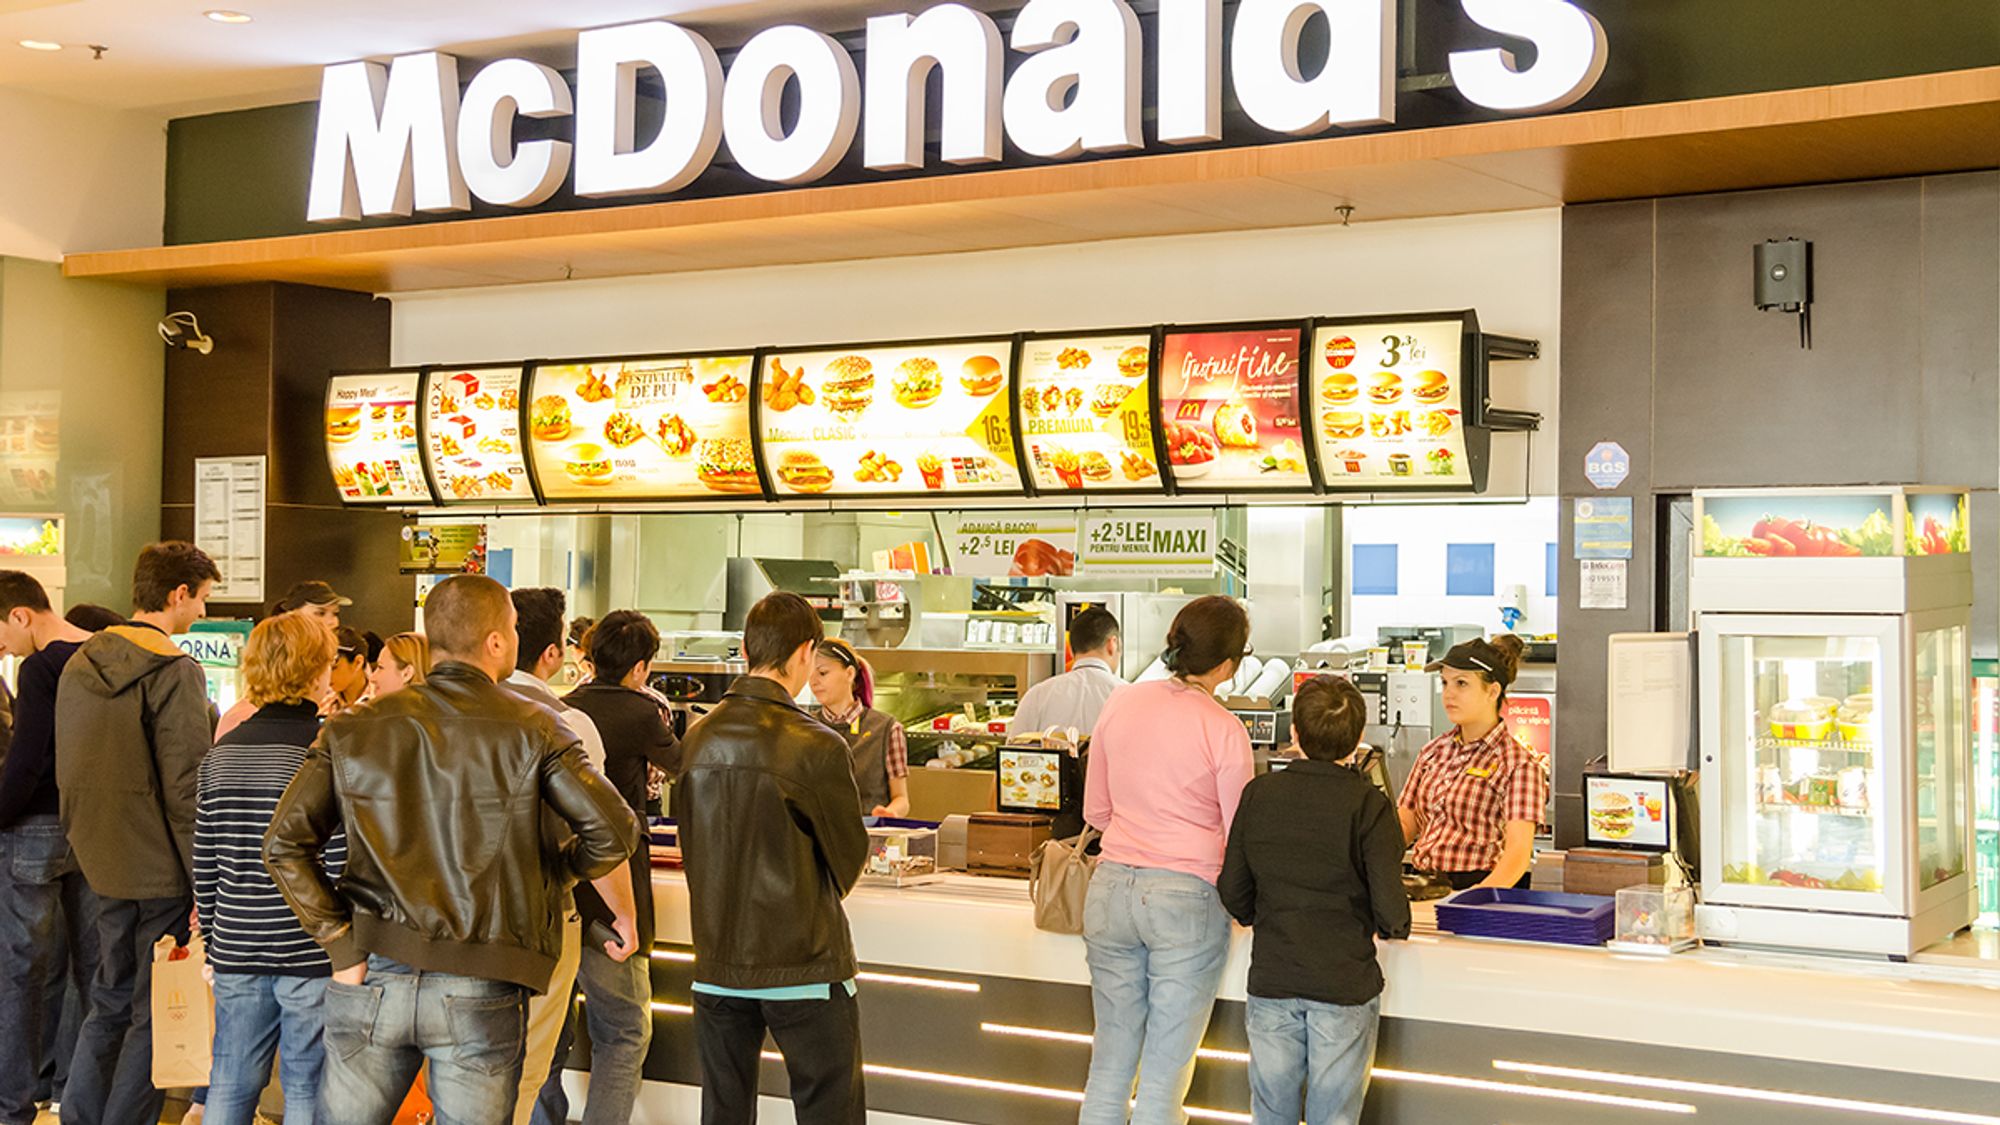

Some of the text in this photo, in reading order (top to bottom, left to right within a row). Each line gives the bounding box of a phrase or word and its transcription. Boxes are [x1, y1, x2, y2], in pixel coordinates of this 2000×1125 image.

[307, 0, 1607, 222] McDonalds
[630, 383, 677, 399] DE PUI
[430, 382, 443, 420] BOX
[1028, 417, 1095, 434] PREMIUM
[1589, 461, 1625, 474] BGS
[1004, 522, 1038, 534] BACON
[1125, 522, 1152, 542] LEI
[994, 540, 1015, 555] LEI
[1090, 543, 1119, 554] PENTRU
[1153, 530, 1207, 554] MAXI
[180, 640, 231, 659] ORNA
